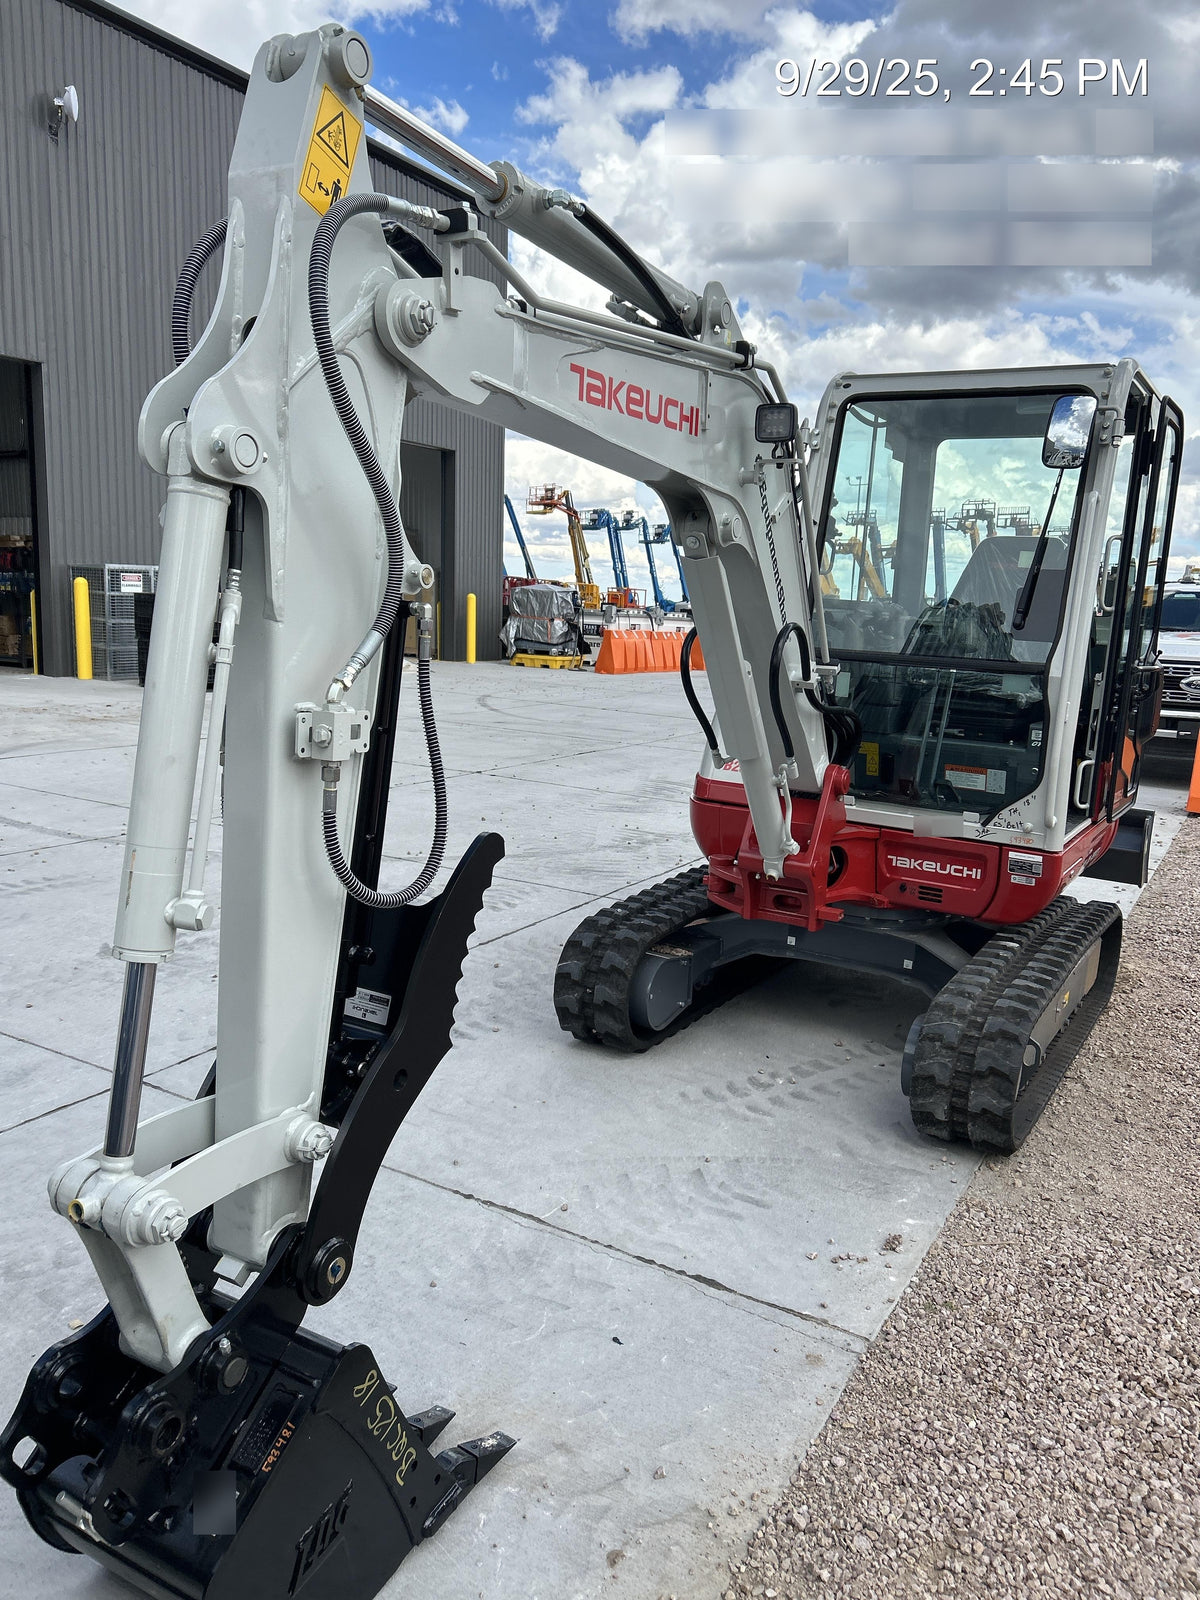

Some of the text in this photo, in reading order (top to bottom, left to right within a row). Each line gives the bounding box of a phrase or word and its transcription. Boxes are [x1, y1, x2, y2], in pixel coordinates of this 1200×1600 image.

[569, 362, 700, 438] TAKEUCHI
[887, 854, 982, 880] TAKEUCHI
[261, 1421, 296, 1473] 593481
